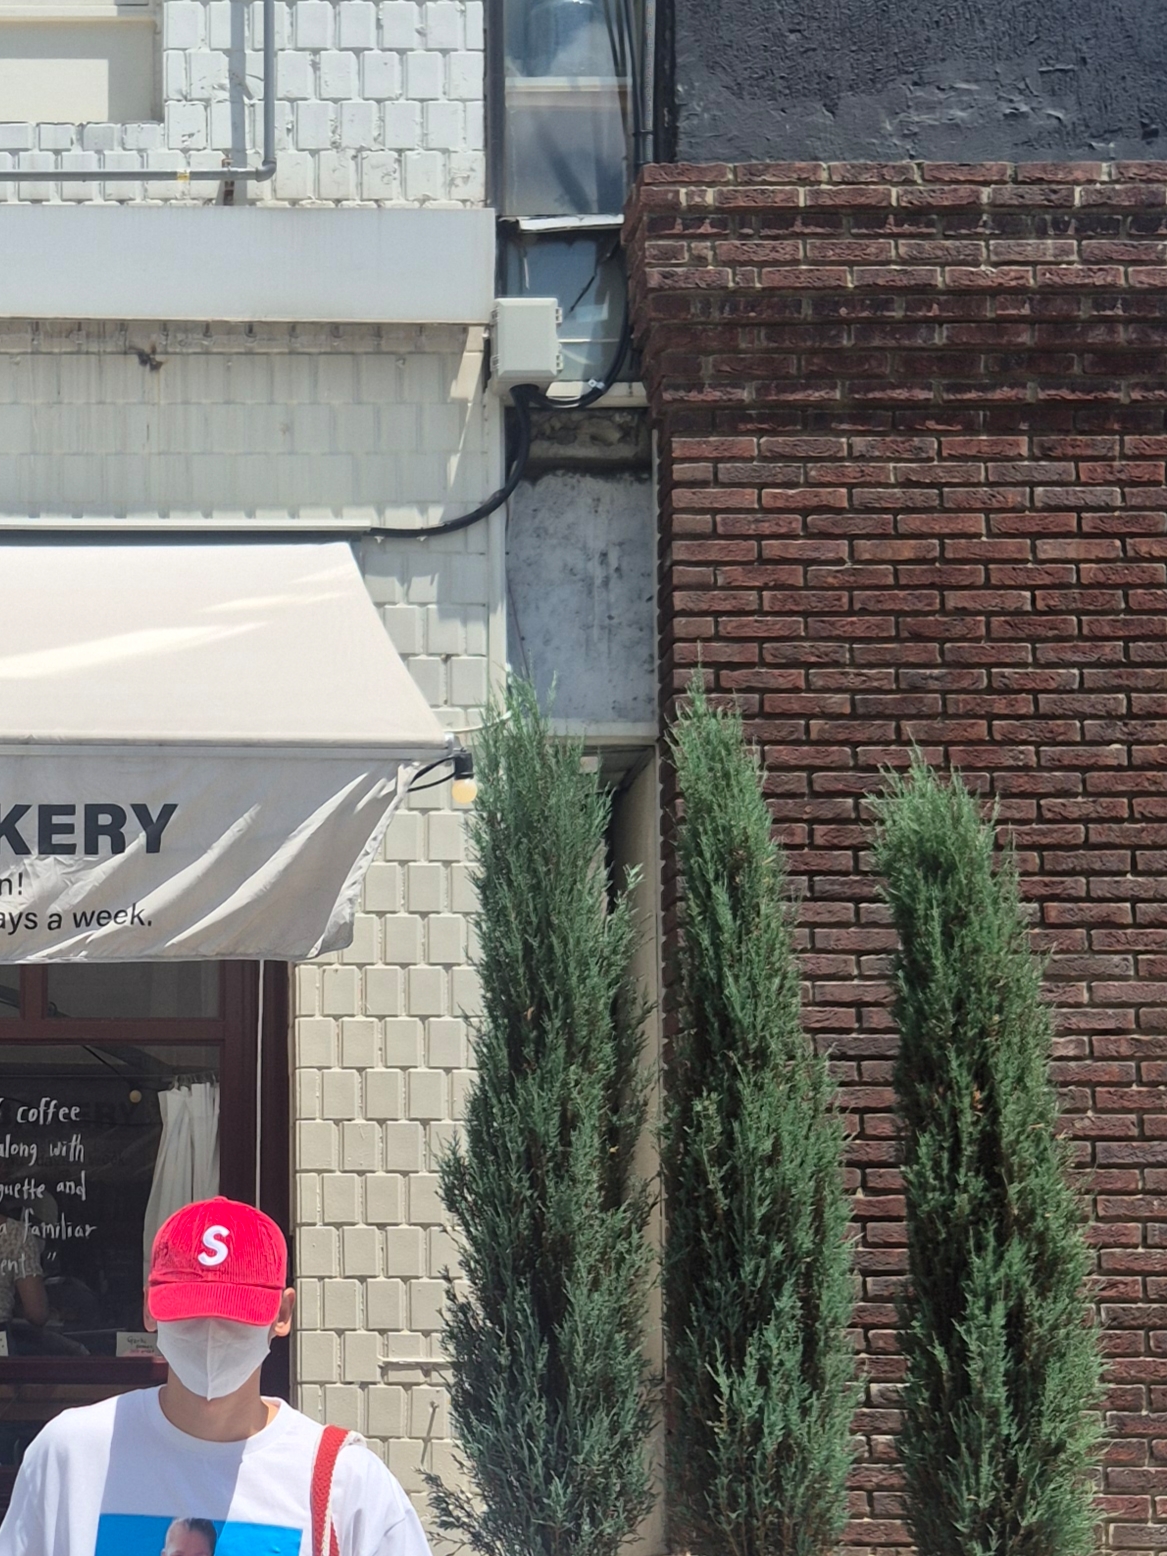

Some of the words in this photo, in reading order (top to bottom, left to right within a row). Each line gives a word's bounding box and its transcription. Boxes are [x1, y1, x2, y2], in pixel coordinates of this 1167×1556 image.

[46, 911, 64, 932] a
[73, 902, 153, 928] week.
[17, 1097, 81, 1125] coffee
[49, 1133, 85, 1162] with
[56, 1170, 87, 1201] and
[21, 1207, 98, 1244] familiar
[197, 1224, 231, 1267] S
